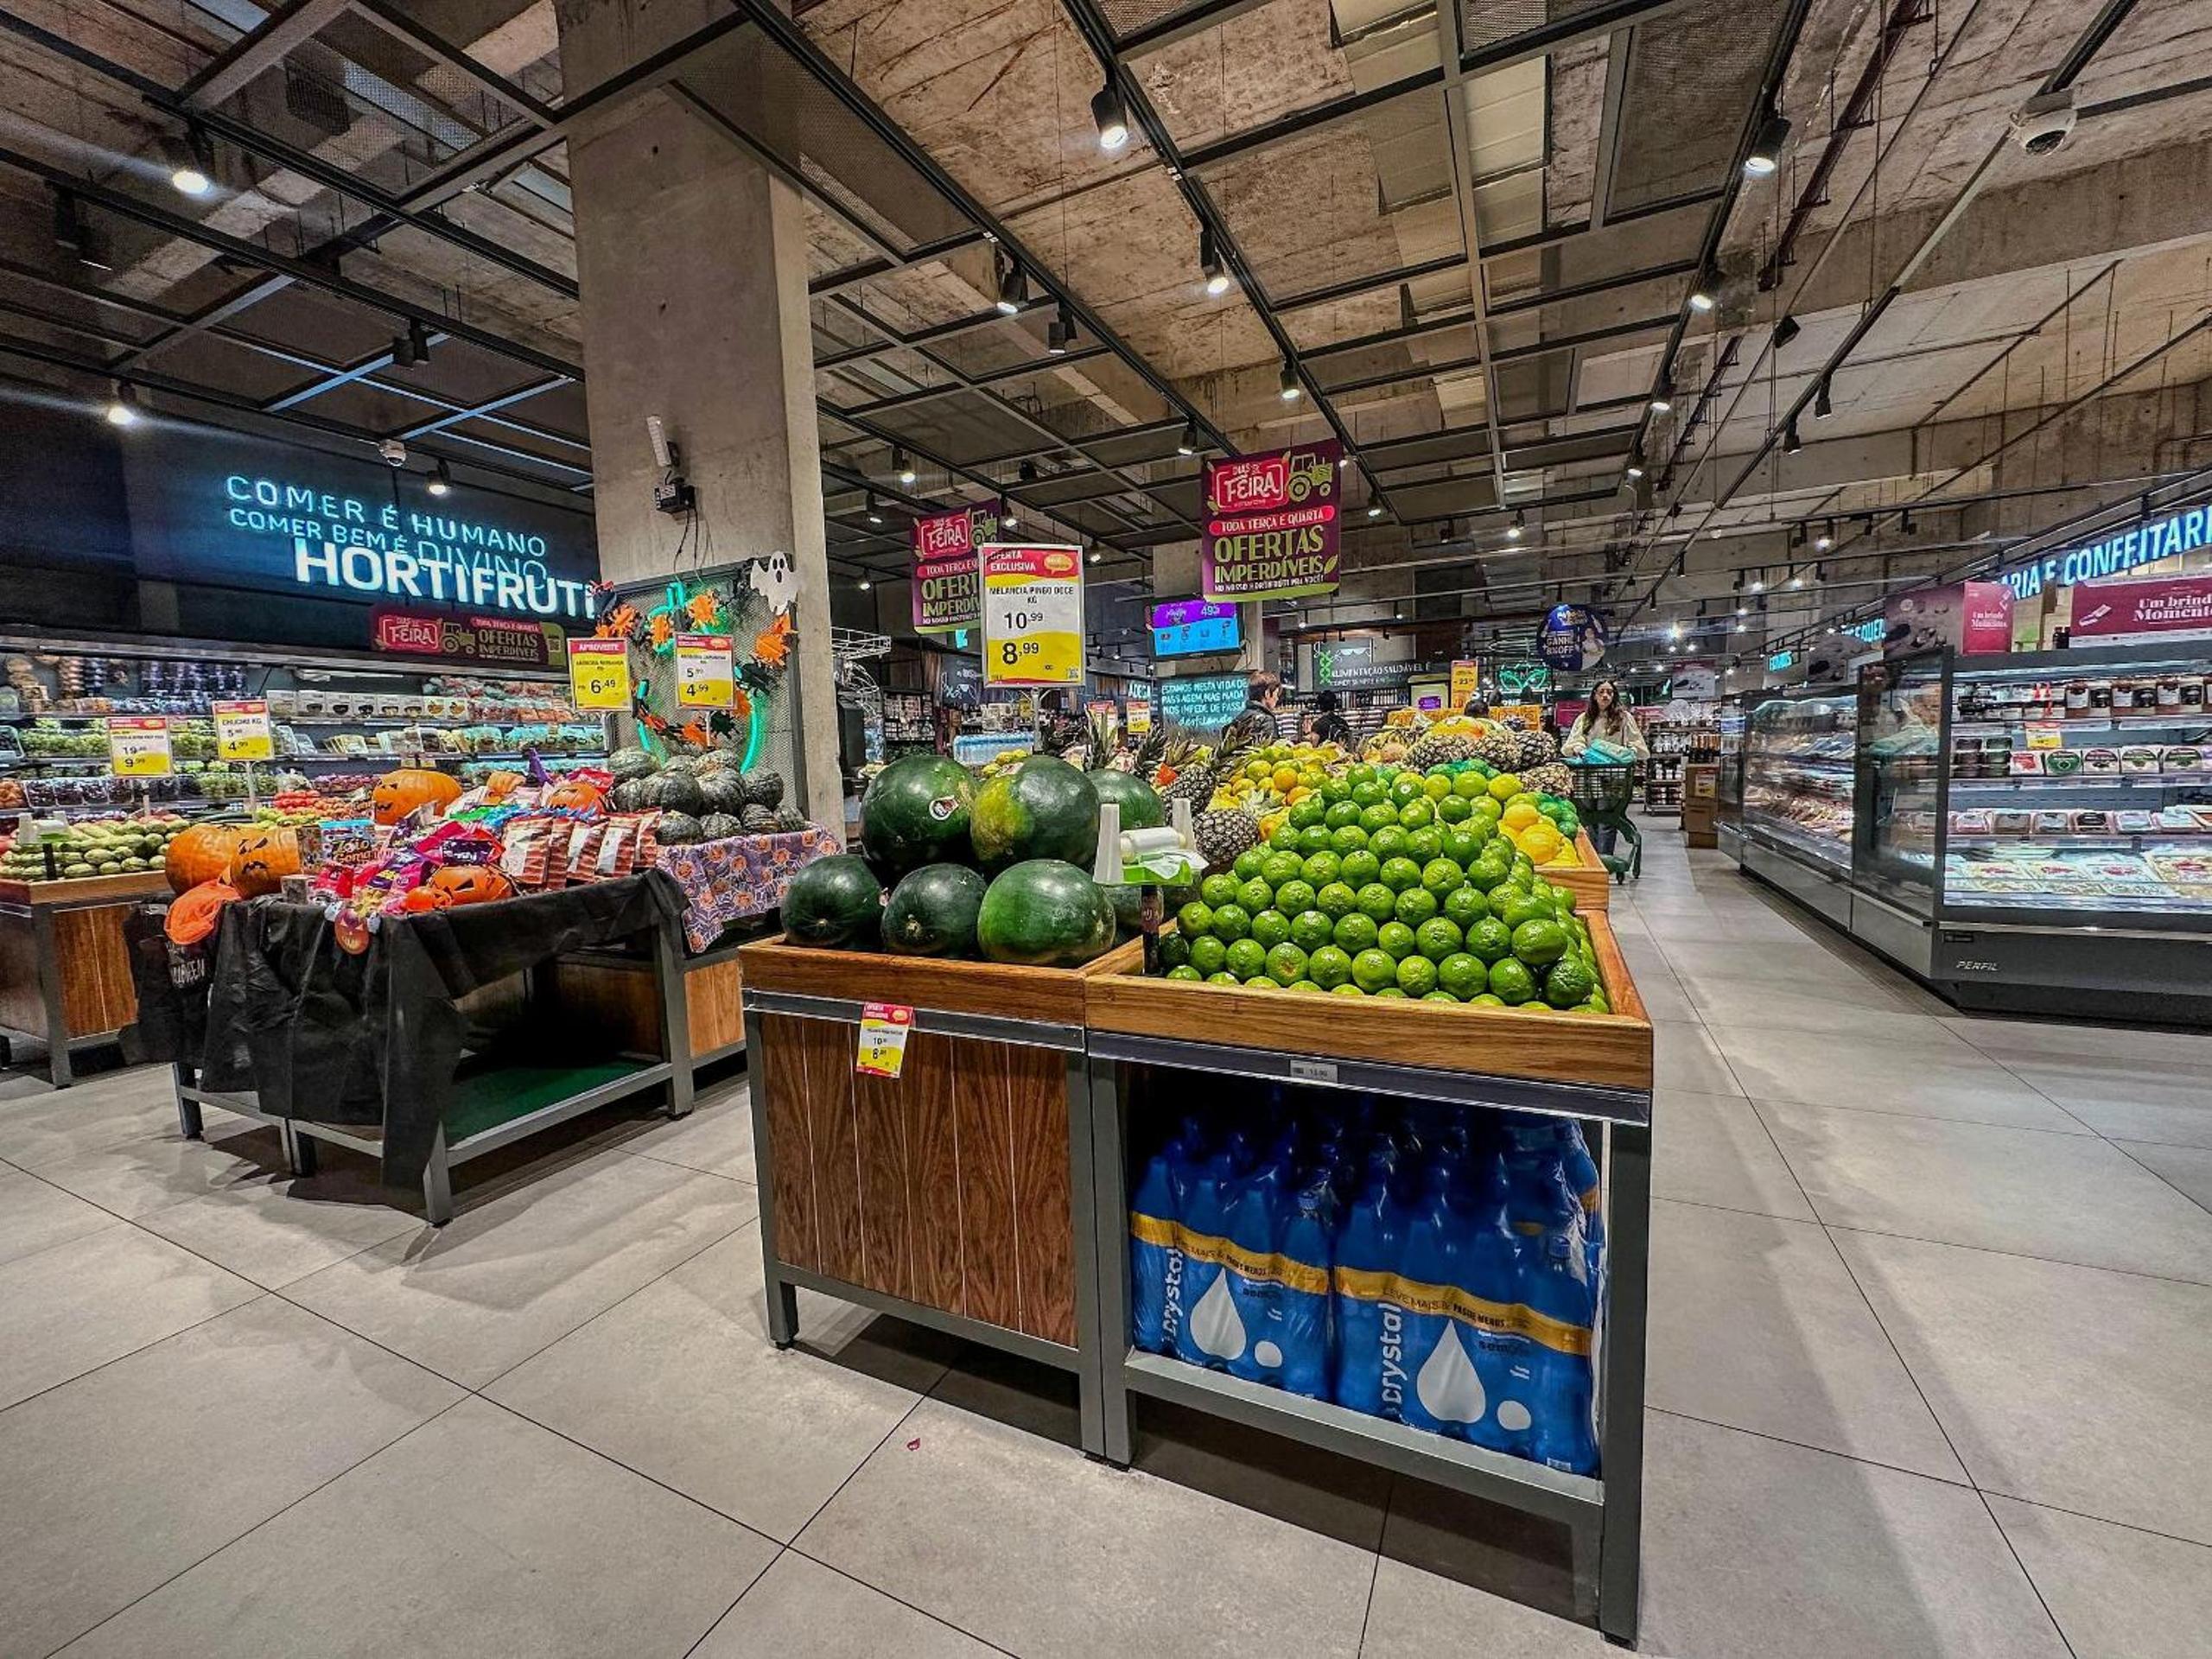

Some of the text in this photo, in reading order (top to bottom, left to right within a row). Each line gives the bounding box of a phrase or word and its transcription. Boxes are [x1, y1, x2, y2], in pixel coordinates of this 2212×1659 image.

[1224, 471, 1279, 502] FEIRA
[227, 475, 545, 557] COMER É HUMANO
[1221, 509, 1324, 532] TODA TERÇA E QUARTA
[926, 524, 965, 551] FEIRA
[1214, 524, 1325, 563] OFERTAS
[230, 508, 547, 589] COMER BEM É DIVINO
[990, 551, 1023, 560] OFERTA
[990, 562, 1036, 571] EXCLUSIVA
[1214, 555, 1325, 584] IMPERDÍVEIS
[295, 537, 594, 619] HORTIFRUTI
[921, 572, 979, 600] OFERT
[2000, 566, 2043, 601] RIA
[989, 587, 1027, 595] MELANCIA
[1027, 595, 1037, 604] KG
[2139, 594, 2212, 609] Um brind
[923, 596, 981, 616] IMPERDÍV
[2133, 605, 2212, 621] Moment
[1004, 612, 1044, 629] 10,99
[389, 623, 435, 645] FEIRA
[478, 629, 538, 648] OFERTAS
[1002, 642, 1039, 664] 8,99
[591, 679, 616, 694] 6,49
[1161, 677, 1249, 695] ESTAMOS NESTA VIDA DE
[1222, 690, 1244, 700] NADA
[1162, 704, 1180, 715] NOS
[1210, 702, 1220, 713] DE
[1955, 961, 1999, 971] PERFIL
[1162, 1249, 1184, 1338] crystal
[1377, 1302, 1408, 1405] crystal
